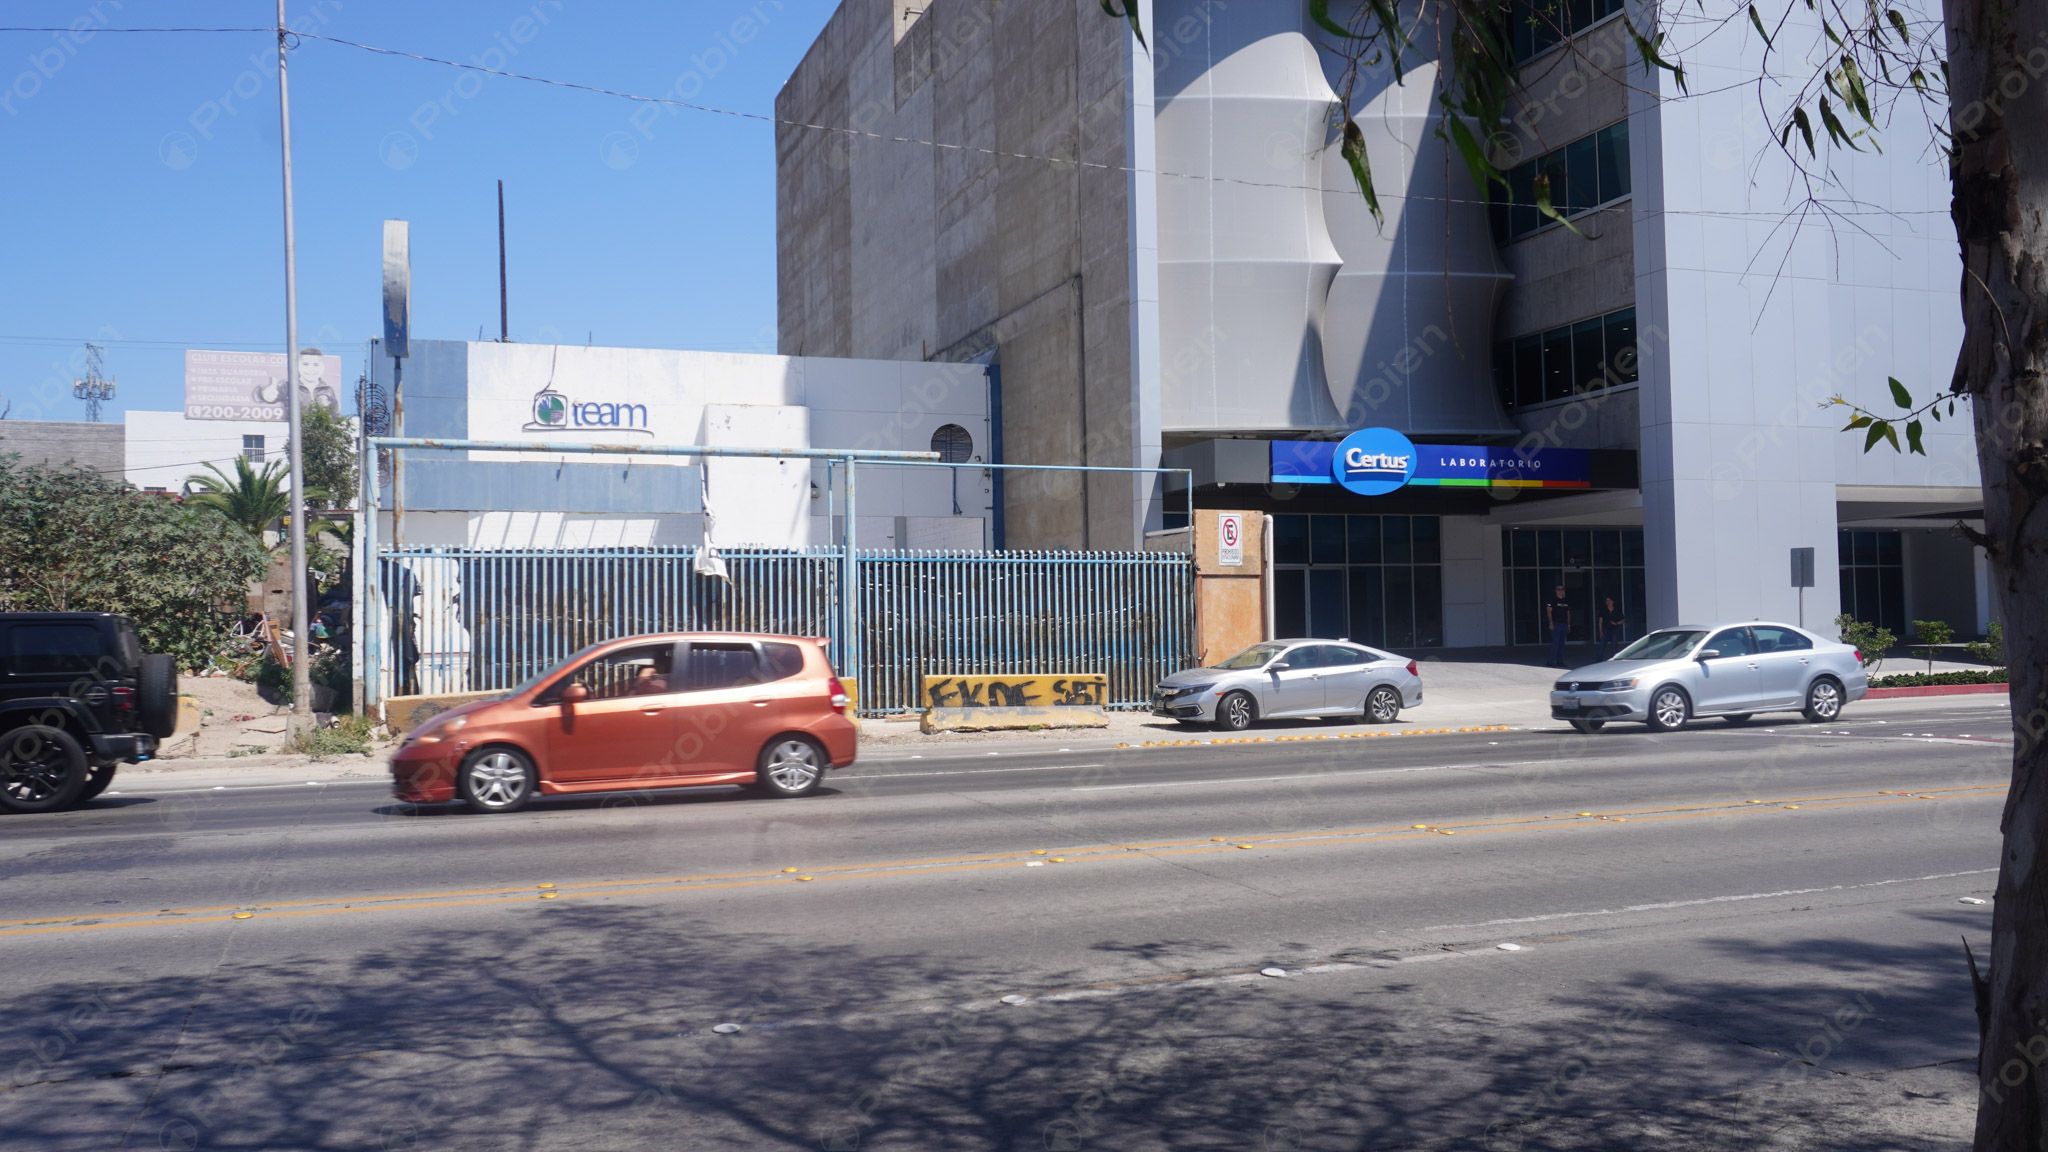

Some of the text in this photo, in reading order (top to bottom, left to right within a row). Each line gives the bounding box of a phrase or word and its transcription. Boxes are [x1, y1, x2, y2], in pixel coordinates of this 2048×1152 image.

[203, 406, 284, 419] 200-2009
[572, 402, 647, 427] team
[1345, 447, 1541, 469] Certus LABORATORIO
